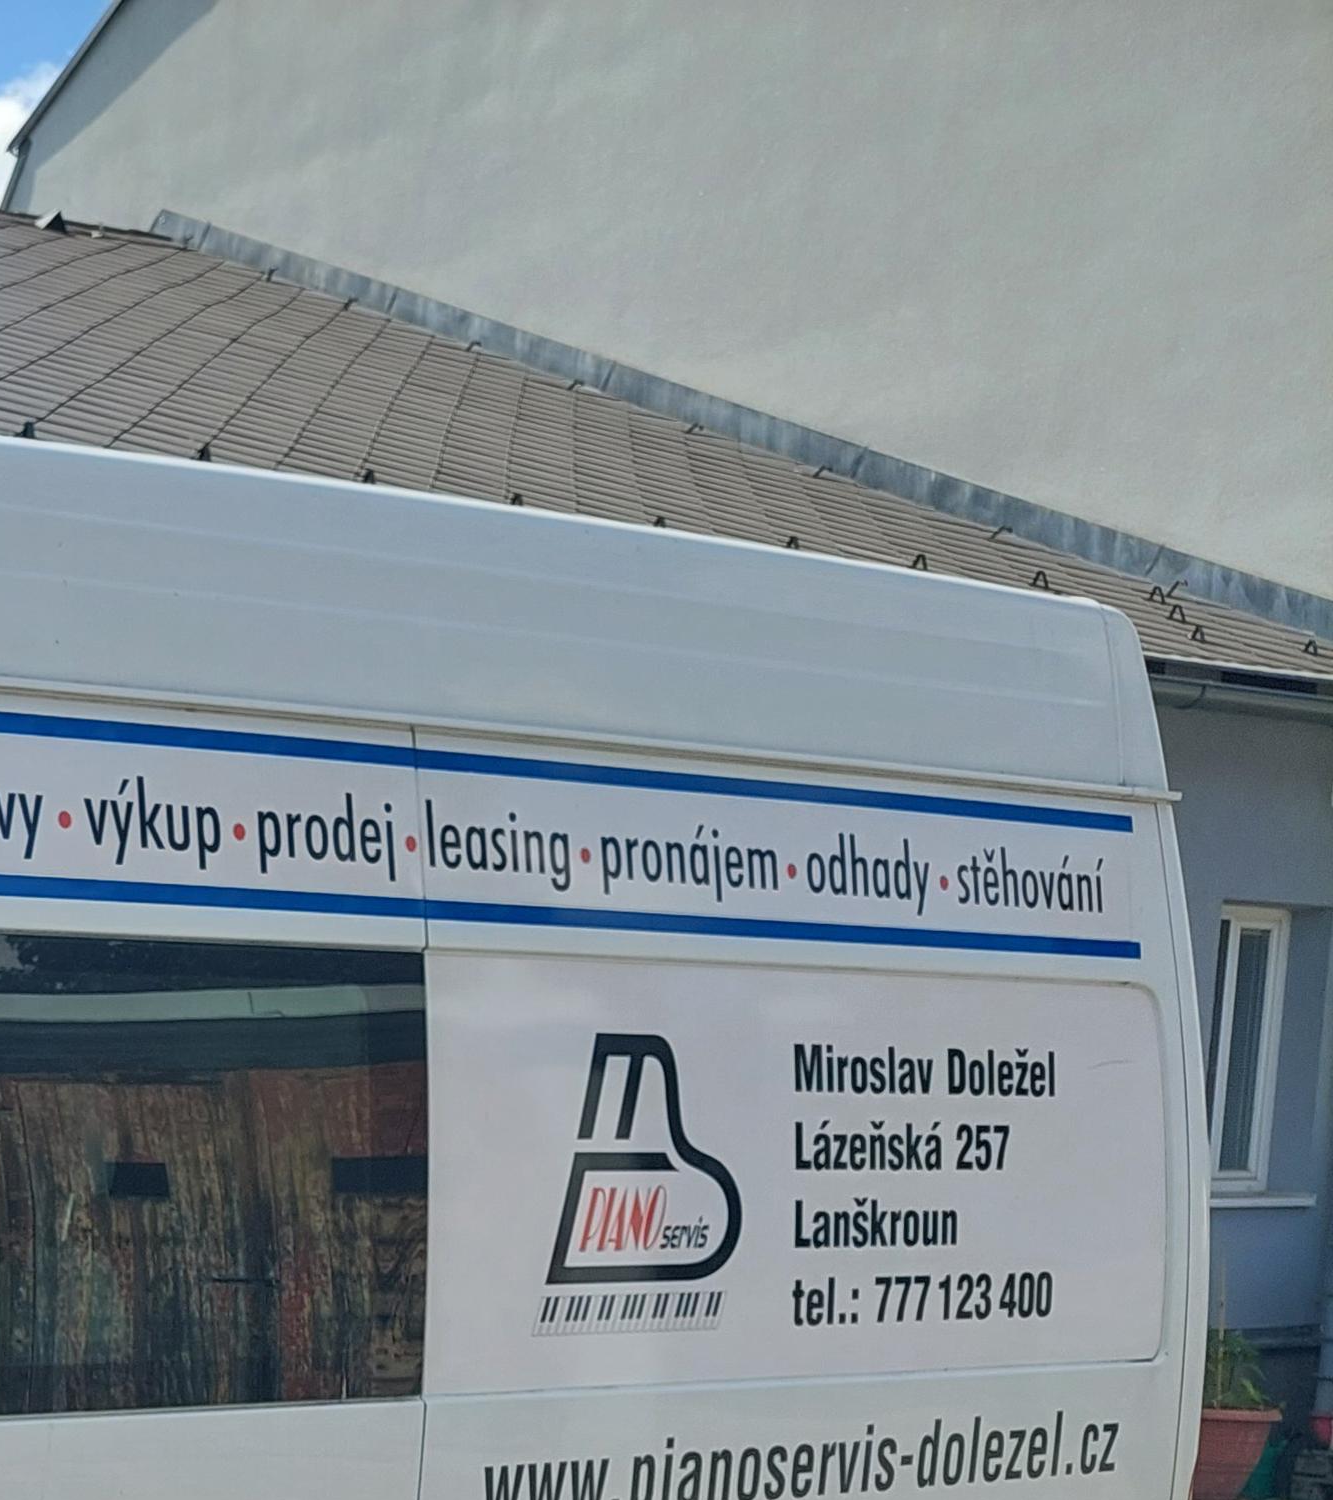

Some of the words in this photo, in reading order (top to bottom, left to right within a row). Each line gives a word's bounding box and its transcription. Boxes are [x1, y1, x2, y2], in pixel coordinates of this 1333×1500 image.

[84, 776, 221, 869] výkup
[256, 792, 396, 882] prodej
[425, 799, 571, 892] leasing
[600, 824, 779, 902] pronájem
[806, 832, 930, 916] odhady
[957, 846, 1104, 914] stěhování
[793, 1043, 934, 1095] Miroslav
[947, 1048, 1056, 1097] Doležel
[794, 1120, 942, 1171] Lázeňská
[956, 1124, 1011, 1171] 257
[579, 1184, 667, 1252] PIANO
[794, 1198, 958, 1249] Lanškroun
[793, 1278, 859, 1326] tel.:
[875, 1276, 931, 1323] 777
[938, 1274, 992, 1321] 123
[999, 1271, 1053, 1318] 400
